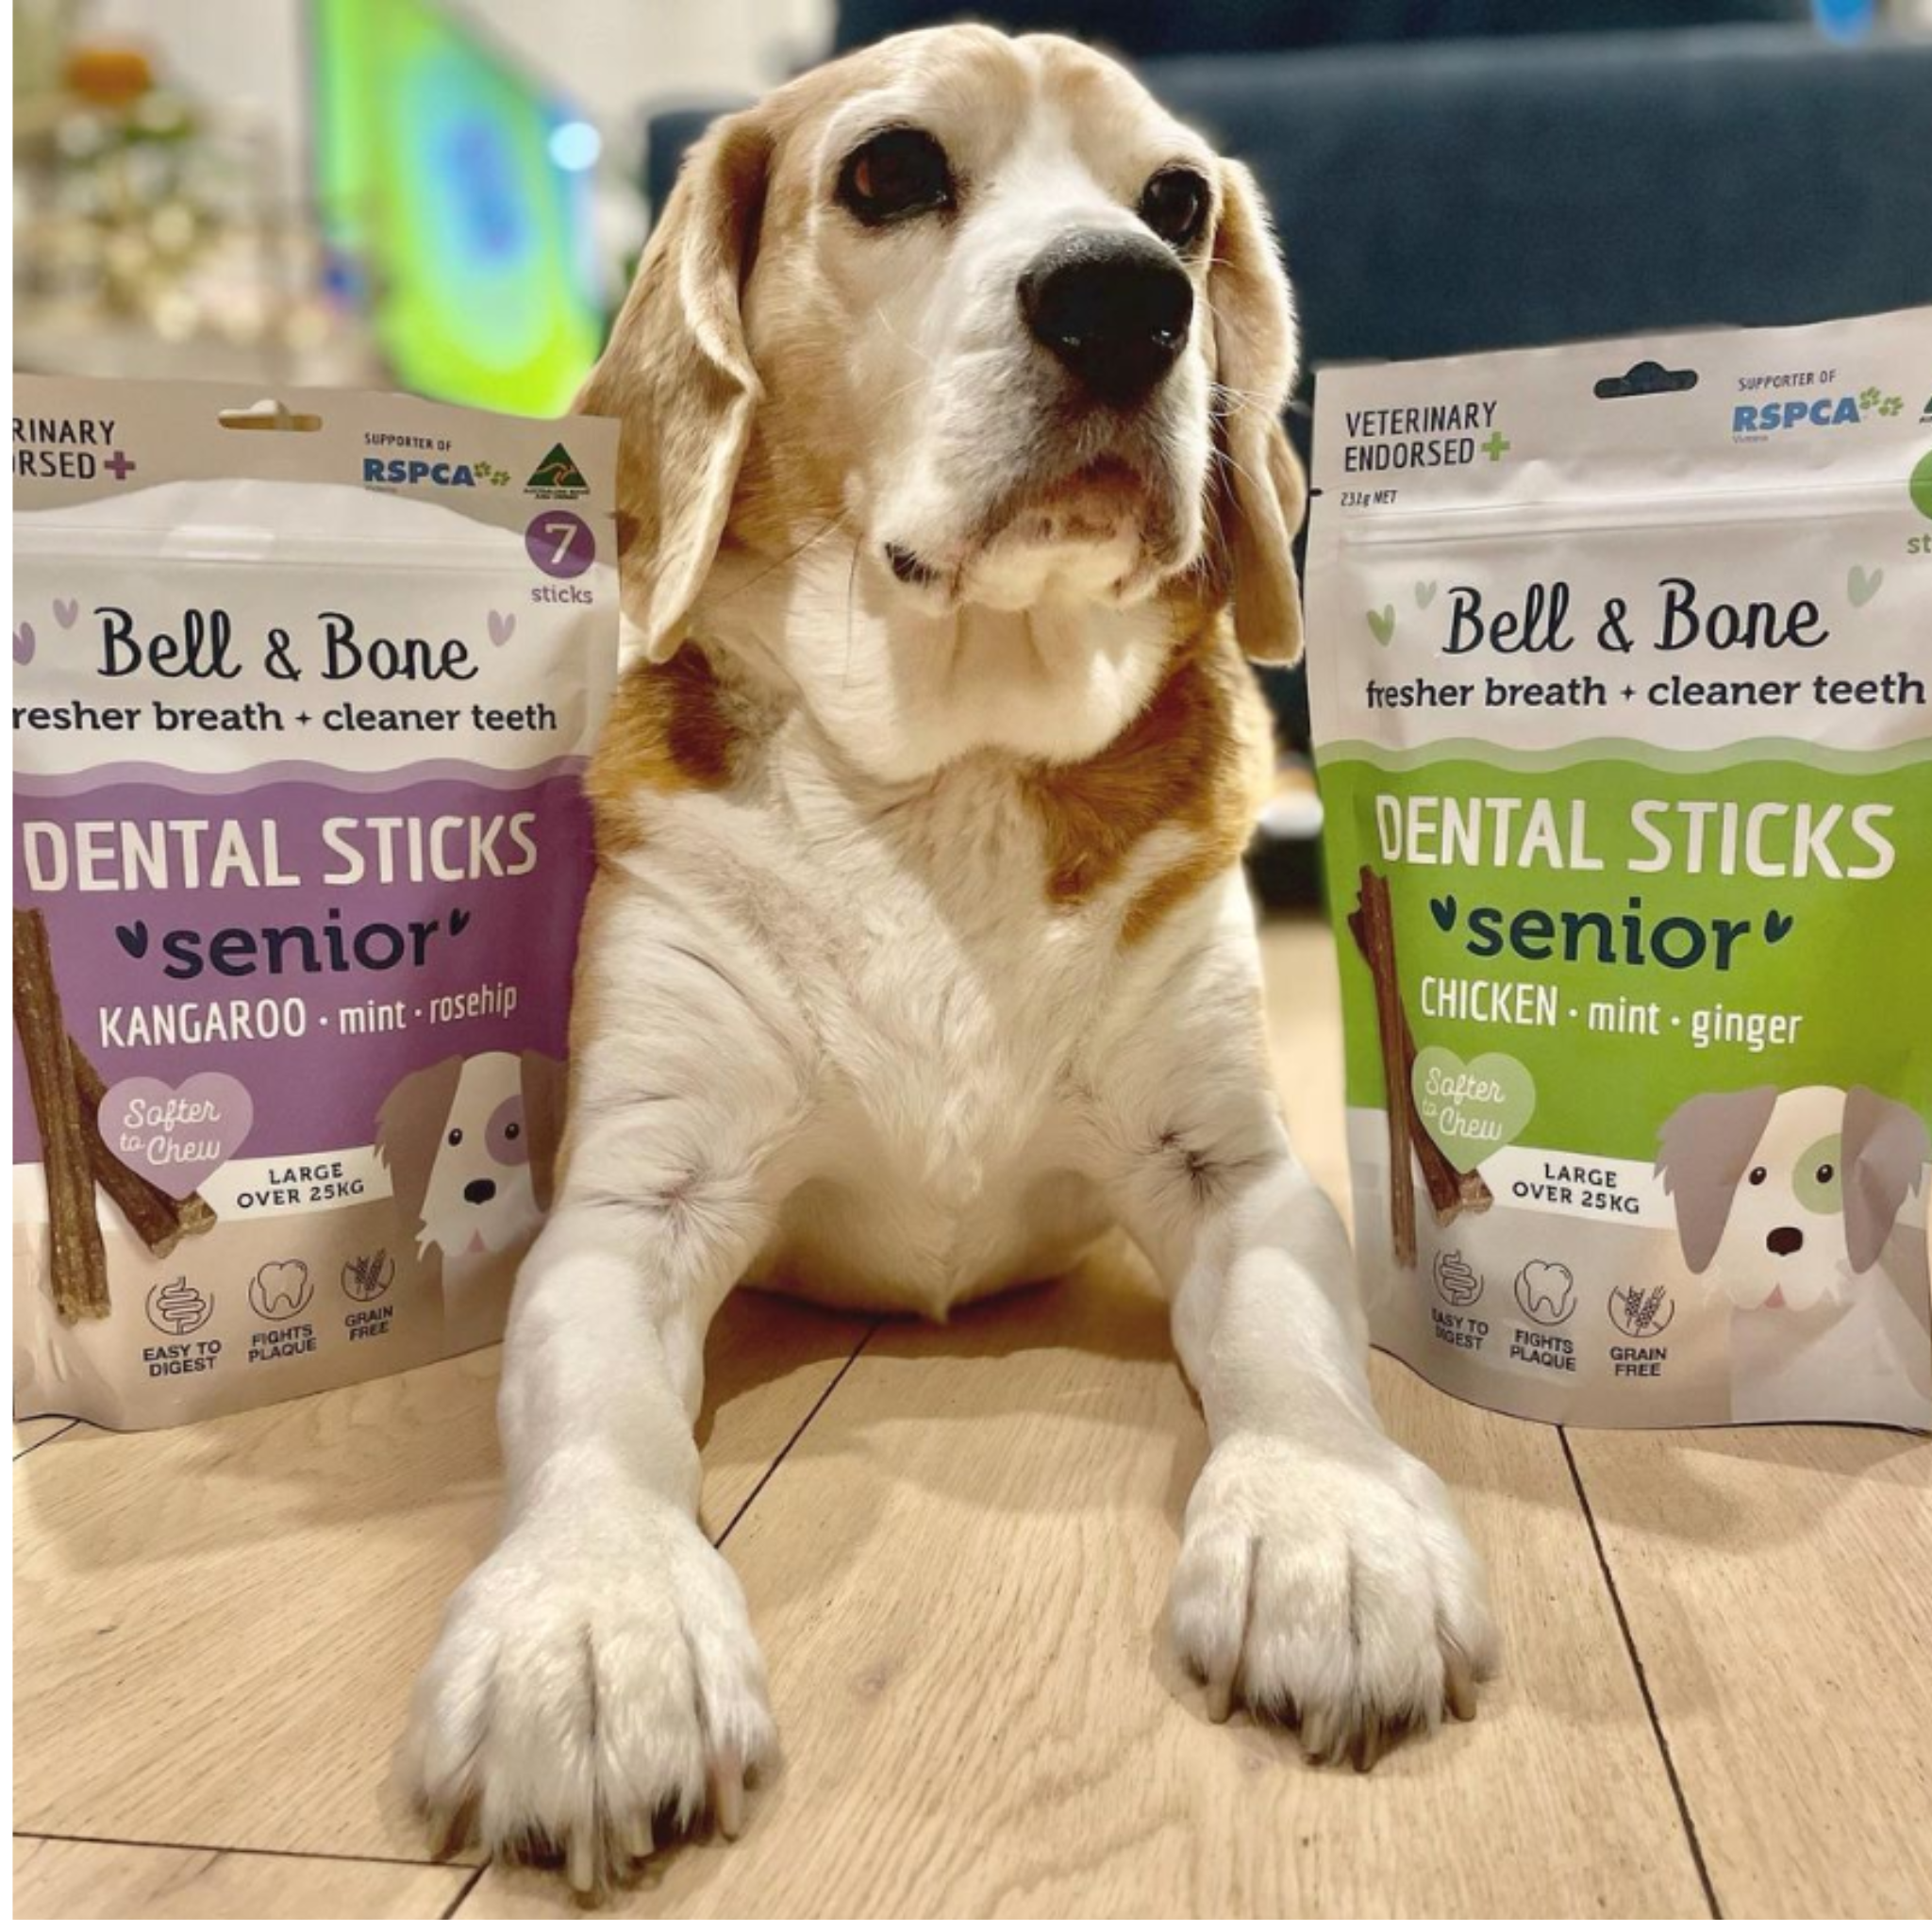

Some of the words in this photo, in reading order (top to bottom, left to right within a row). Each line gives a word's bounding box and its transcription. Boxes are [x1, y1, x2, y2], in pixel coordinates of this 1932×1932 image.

[1738, 372, 1814, 391] SUPPORTER
[1820, 369, 1837, 383] OF
[1345, 400, 1497, 438] VETERINARY
[1733, 397, 1860, 432] RSPCA
[364, 432, 433, 450] SUPPORTER
[437, 440, 452, 451] OF
[1344, 438, 1475, 472] ENDORSED
[12, 449, 96, 479] RSED
[363, 458, 475, 487] RSPCA
[1373, 490, 1398, 504] NET
[544, 523, 577, 564] 7
[531, 585, 593, 604] sticks
[1441, 581, 1574, 654] Bell
[1597, 597, 1635, 653] &
[1654, 577, 1829, 651] Bone
[93, 607, 242, 678] Bell
[264, 628, 302, 681] &
[318, 611, 478, 680] Bone
[1366, 678, 1474, 708] fresher
[1485, 676, 1607, 707] breath
[1648, 675, 1801, 705] cleaner
[1813, 672, 1926, 704] teeth
[152, 701, 284, 731] breath
[323, 703, 460, 731] cleaner
[472, 704, 557, 731] teeth
[23, 819, 301, 891] DENTAL
[322, 812, 538, 885] STICKS
[1375, 794, 1605, 870] DENTAL
[1627, 799, 1895, 879] STICKS
[162, 908, 440, 979] senior
[1466, 896, 1751, 971] senior
[99, 996, 307, 1048] KANGAROO
[339, 1000, 407, 1035] mint
[429, 982, 518, 1024] rosehip
[1421, 975, 1557, 1026] CHICKEN
[1588, 996, 1660, 1036] mint
[1691, 1004, 1804, 1052] ginger
[1425, 1067, 1506, 1105] Softer
[124, 1099, 221, 1131] Softer
[1422, 1098, 1438, 1116] to
[1440, 1107, 1502, 1141] Chew
[120, 1134, 143, 1153] to
[146, 1137, 220, 1165] Chew
[269, 1162, 343, 1185] LARGE
[1544, 1162, 1617, 1189] LARGE
[237, 1191, 301, 1208] OVER
[309, 1179, 364, 1203] 25KG
[1512, 1181, 1573, 1204] OVER
[1581, 1191, 1640, 1215] 25KG
[344, 1306, 393, 1327] GRAIN
[349, 1321, 390, 1341] FREE
[1468, 1319, 1489, 1336] TO
[248, 1337, 317, 1363] PLAQUE
[252, 1324, 313, 1346] FIGHTS
[1515, 1328, 1574, 1354] FIGHTS
[142, 1345, 192, 1361] EASY
[197, 1340, 222, 1355] TO
[1509, 1345, 1575, 1372] PLAQUE
[1610, 1346, 1667, 1361] GRAIN
[149, 1355, 217, 1377] DIGEST
[1615, 1363, 1660, 1376] FREE
